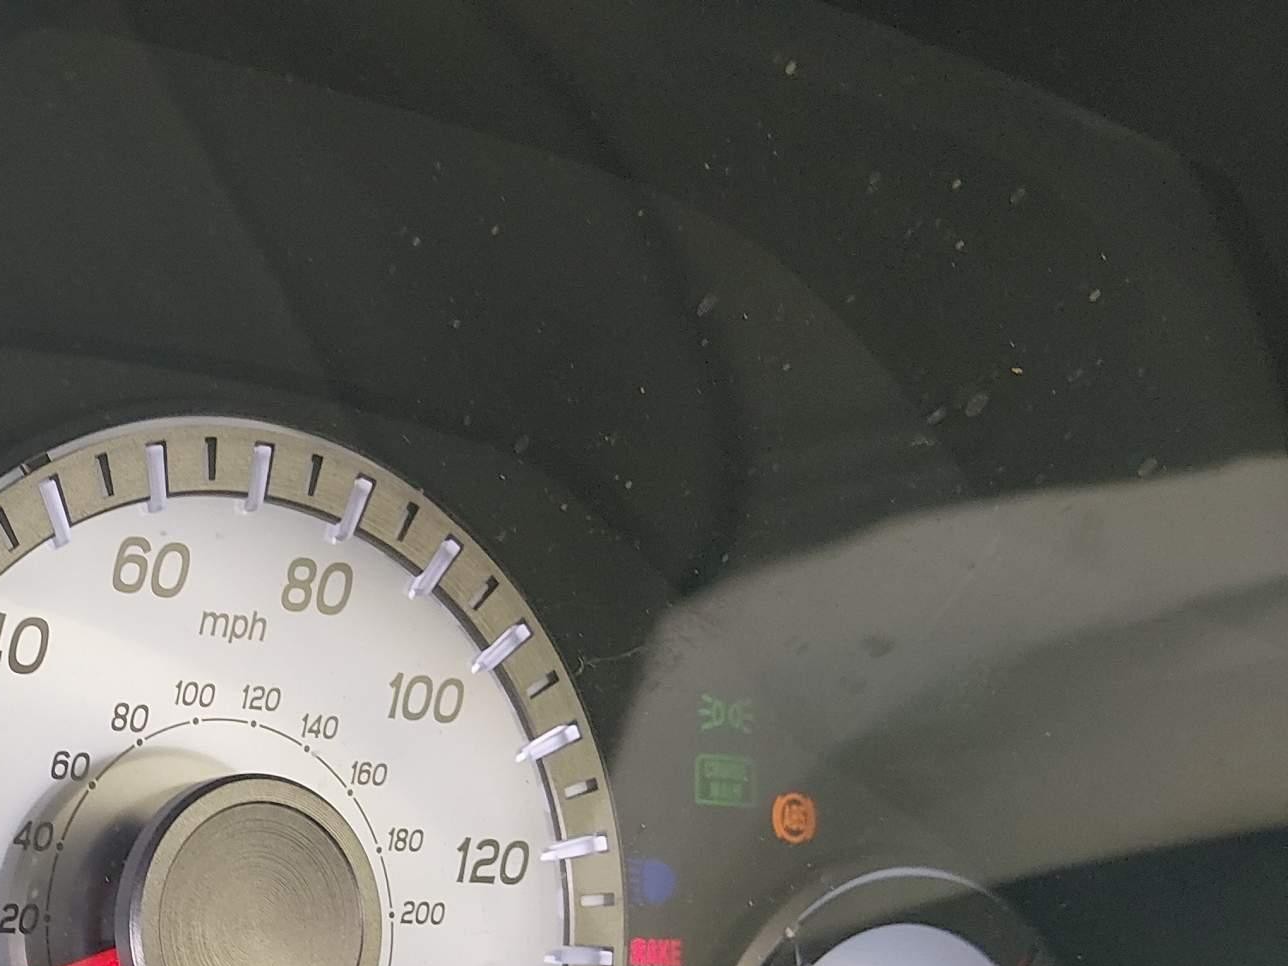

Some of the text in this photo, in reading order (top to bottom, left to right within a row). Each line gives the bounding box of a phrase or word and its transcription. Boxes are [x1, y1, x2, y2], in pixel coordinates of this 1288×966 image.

[112, 536, 191, 598] 60
[281, 557, 354, 614] 80
[199, 610, 268, 644] mph
[174, 681, 216, 707] 100
[240, 686, 282, 713] 120
[387, 672, 465, 723] 100
[111, 702, 149, 733] 80
[301, 714, 339, 741] 140
[50, 750, 90, 780] 60
[349, 762, 387, 787] 160
[13, 822, 54, 852] 40
[387, 829, 424, 853] 180
[456, 837, 529, 885] 120
[400, 900, 445, 926] 200
